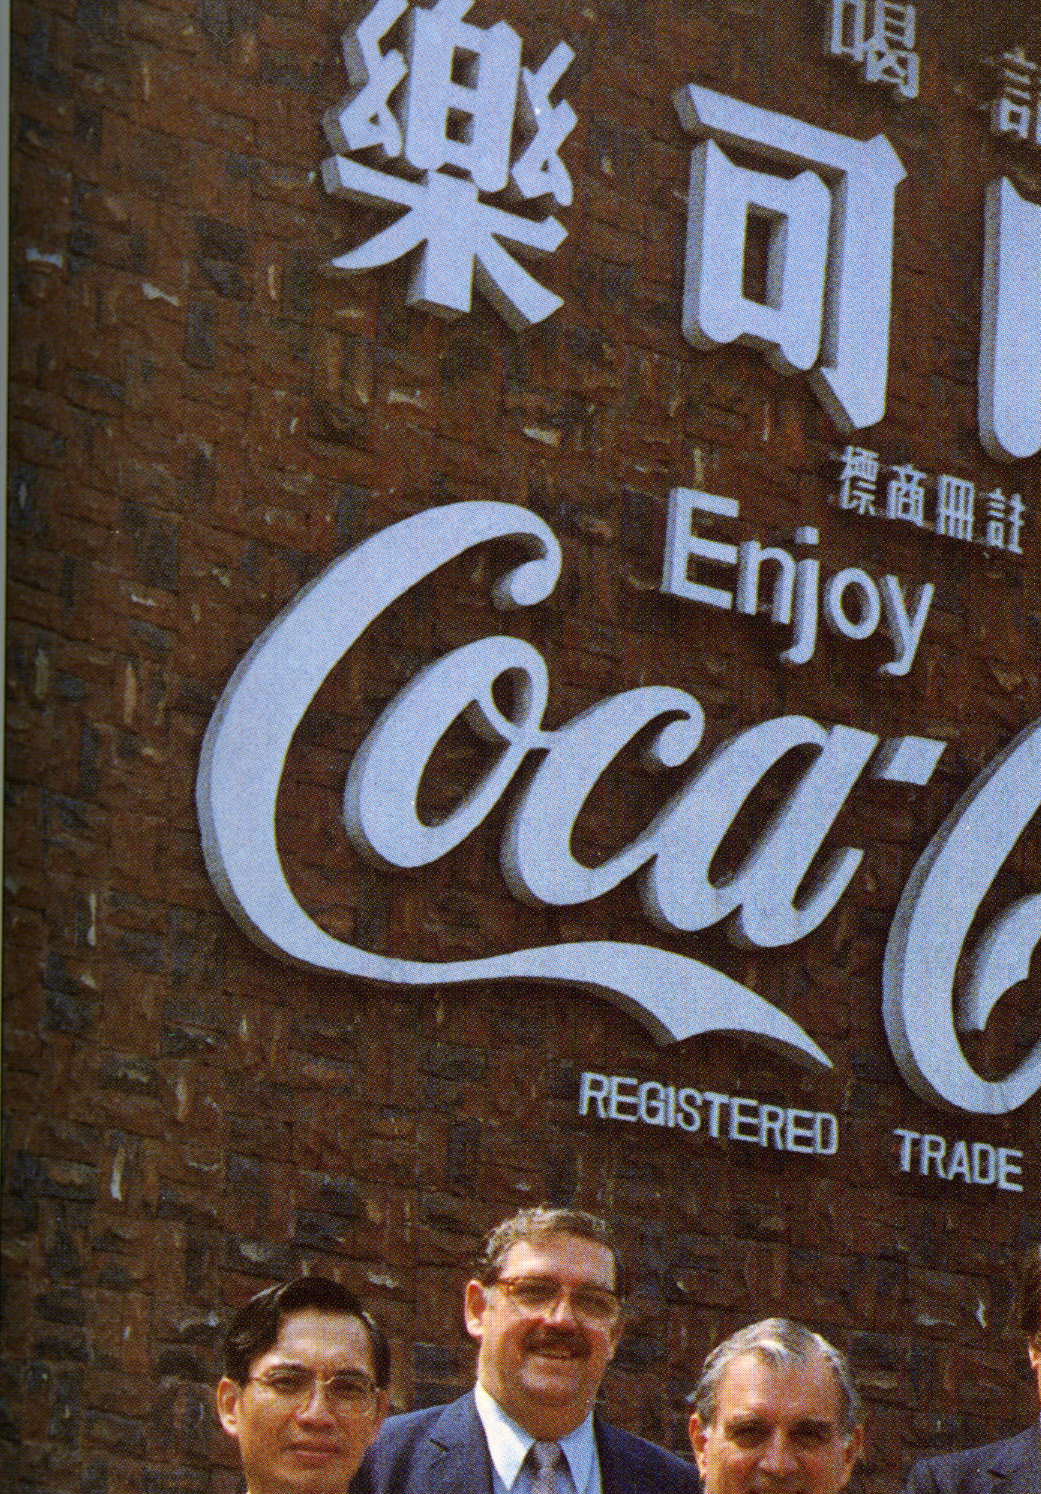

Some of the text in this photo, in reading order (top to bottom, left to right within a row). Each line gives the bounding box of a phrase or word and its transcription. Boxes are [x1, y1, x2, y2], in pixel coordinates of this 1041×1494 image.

[660, 486, 936, 678] Enjoy
[578, 1071, 839, 1156] REGISTERED
[893, 1127, 1025, 1193] TRADE
